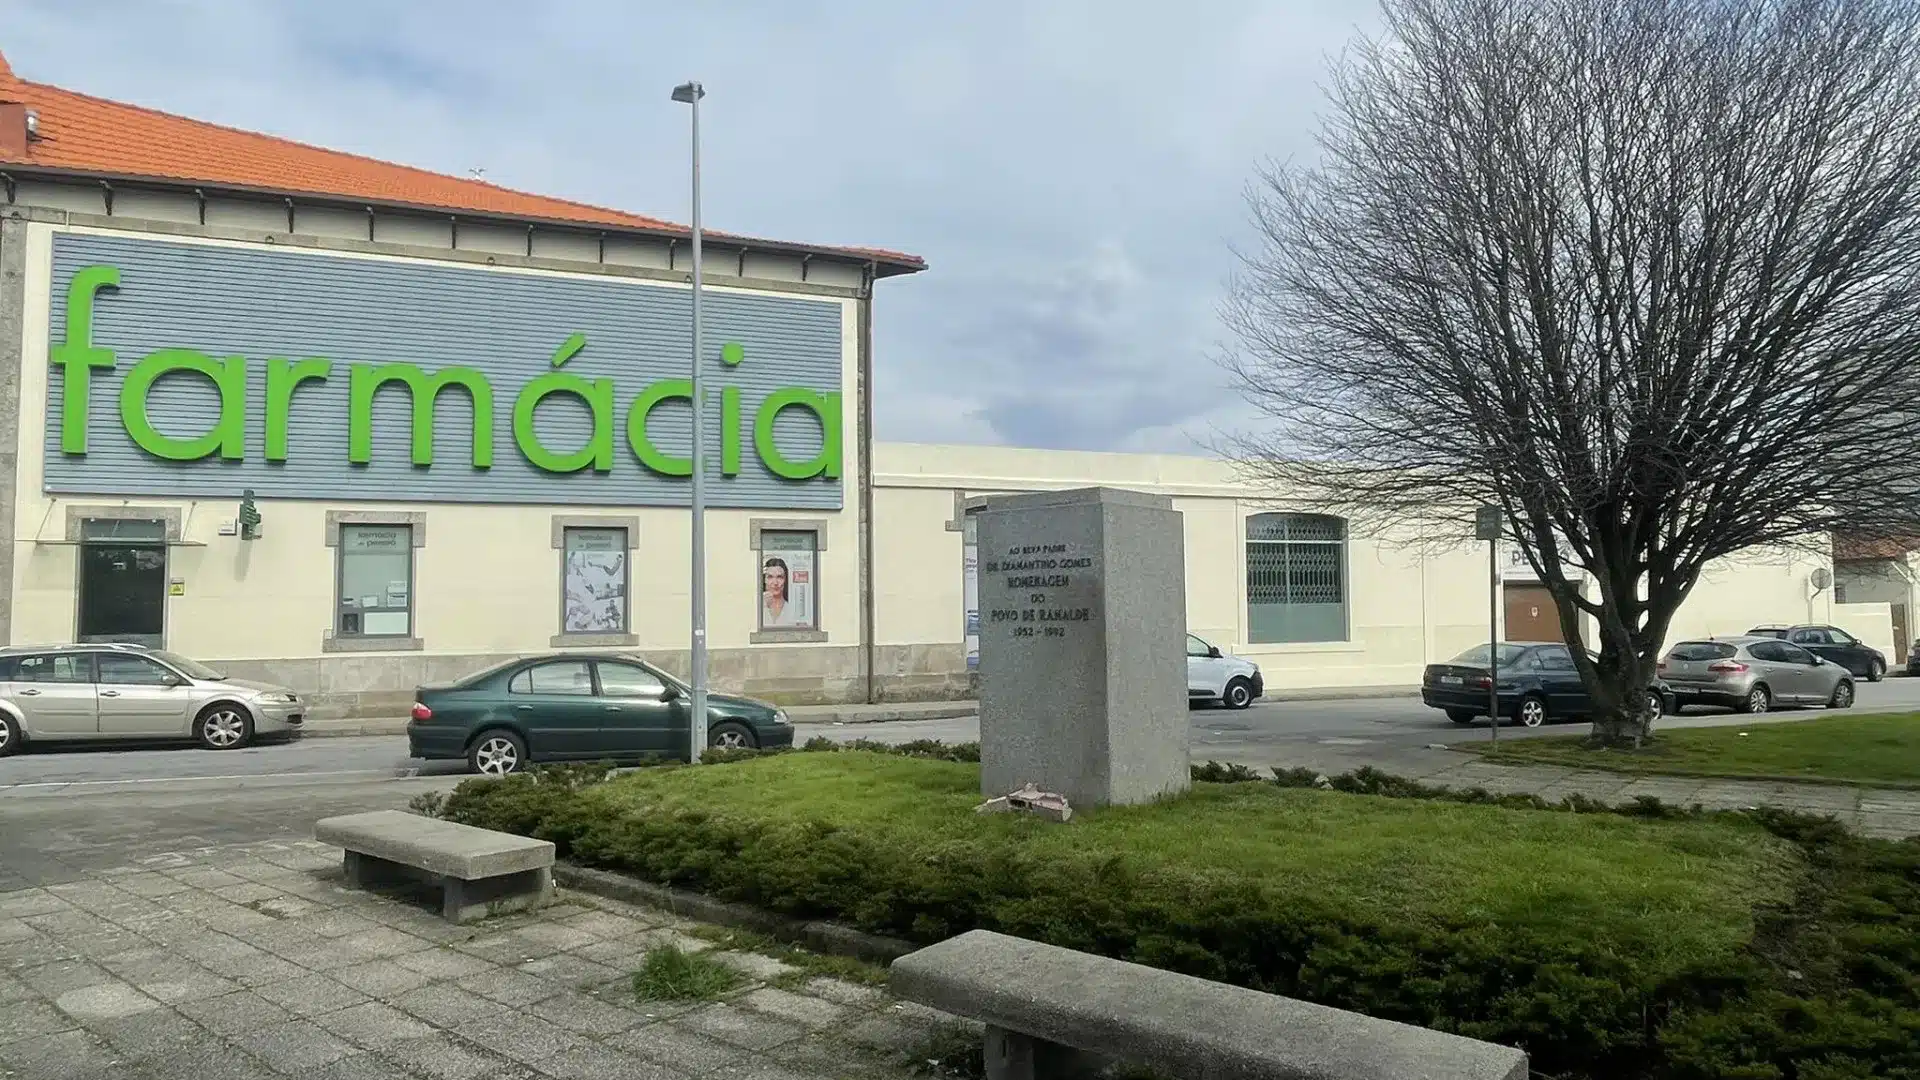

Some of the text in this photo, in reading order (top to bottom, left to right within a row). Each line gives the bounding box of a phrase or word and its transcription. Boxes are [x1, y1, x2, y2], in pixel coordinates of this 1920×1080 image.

[50, 264, 843, 480] farmácia
[1001, 559, 1057, 571] DIAMANTINO
[1060, 557, 1092, 568] GOMES
[1008, 575, 1069, 588] HOMENAGEM
[1031, 593, 1046, 604] DO
[991, 607, 1090, 621] POVO DE RAMALDE
